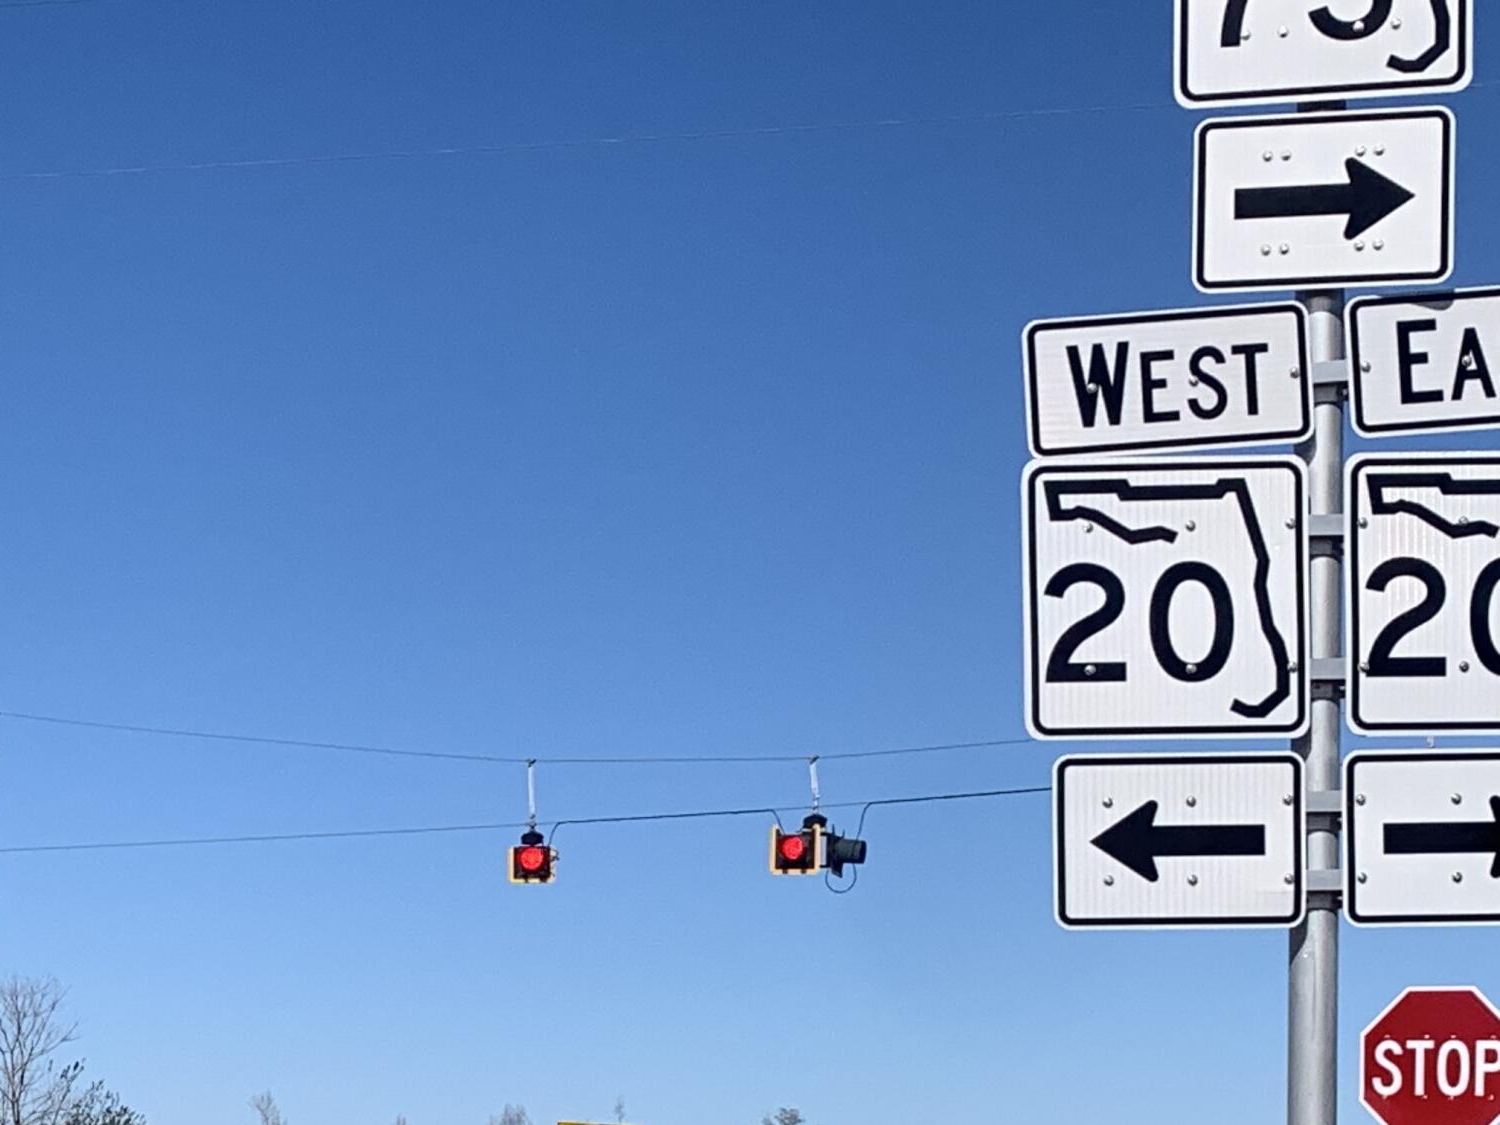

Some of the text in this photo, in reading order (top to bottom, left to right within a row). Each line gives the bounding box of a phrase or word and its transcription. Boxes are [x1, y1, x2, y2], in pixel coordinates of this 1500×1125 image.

[1065, 340, 1269, 428] WEST
[1043, 560, 1235, 683] 20
[1371, 1039, 1500, 1097] STOP
